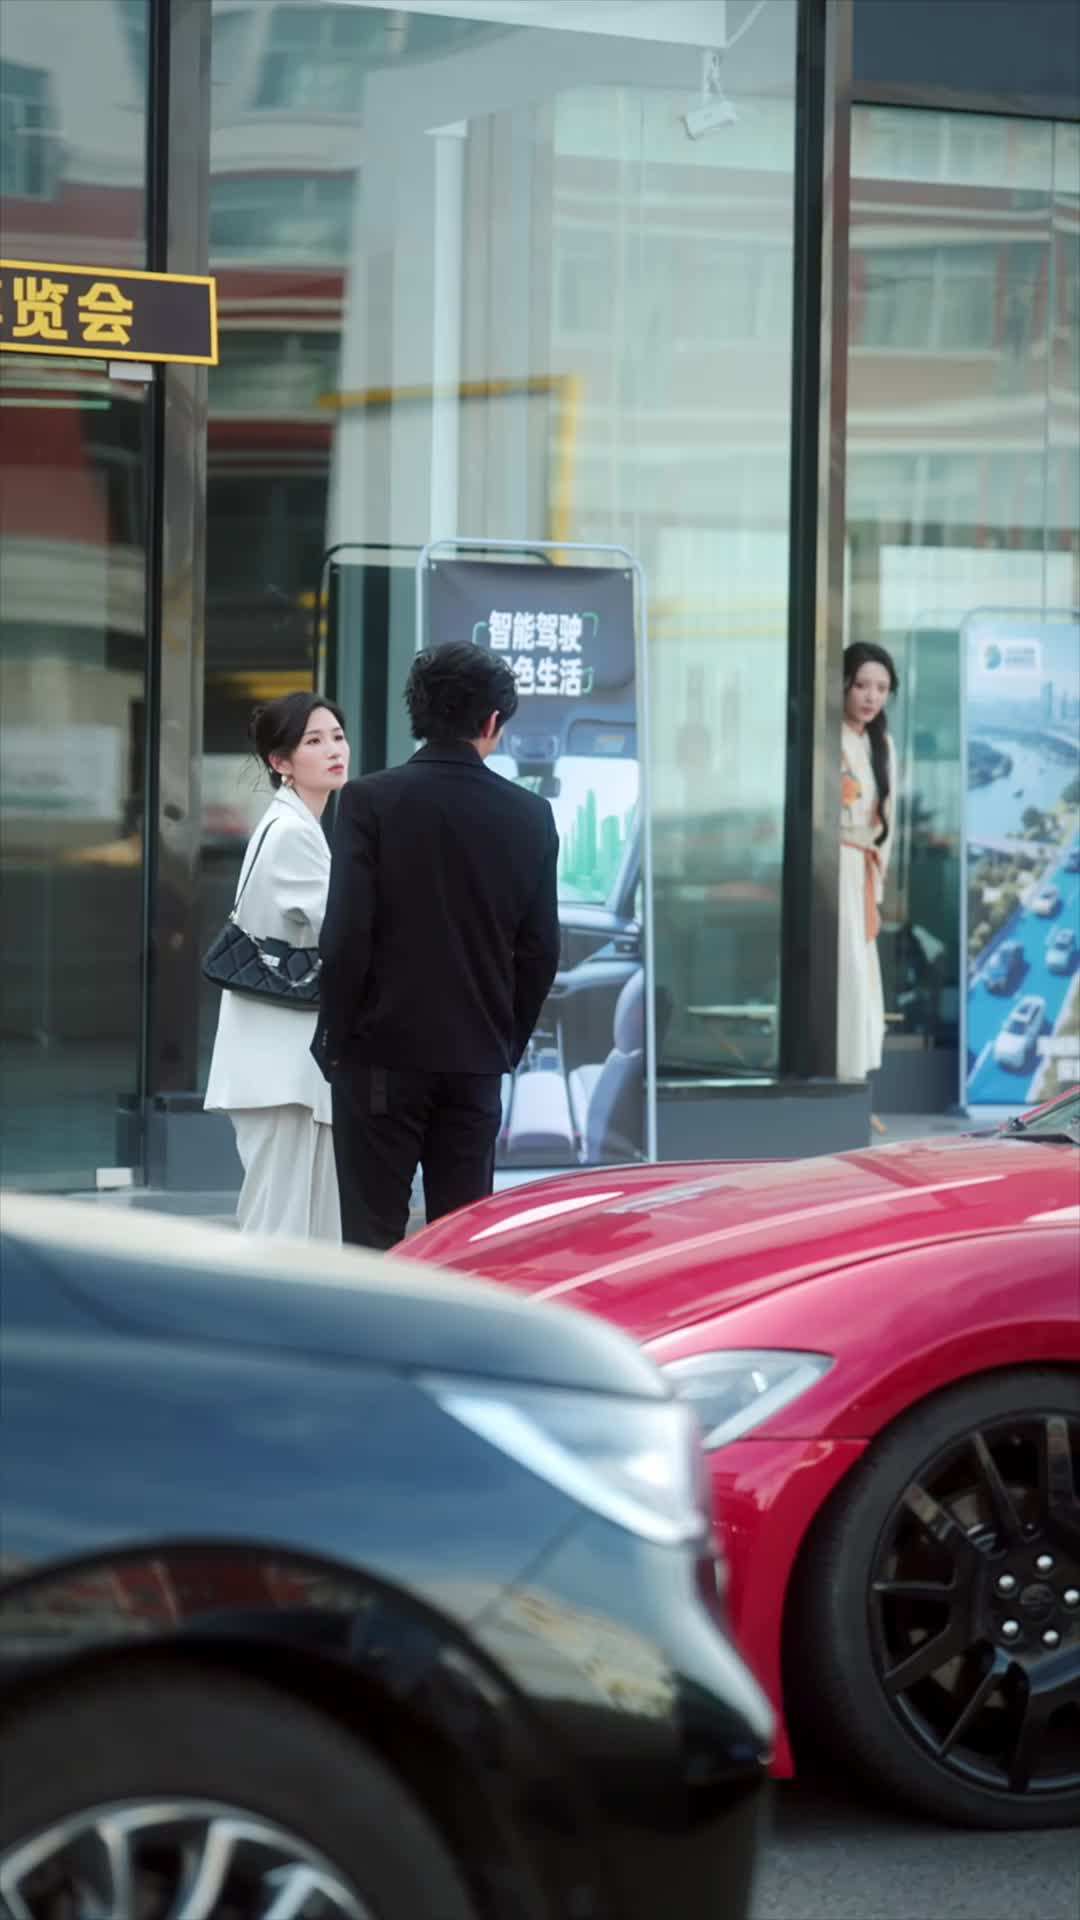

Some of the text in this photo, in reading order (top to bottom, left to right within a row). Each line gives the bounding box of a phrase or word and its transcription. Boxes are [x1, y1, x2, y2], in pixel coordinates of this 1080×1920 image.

[0, 276, 134, 346] 览会
[488, 610, 583, 652] 智能驾驶
[501, 655, 582, 697] 色生活
